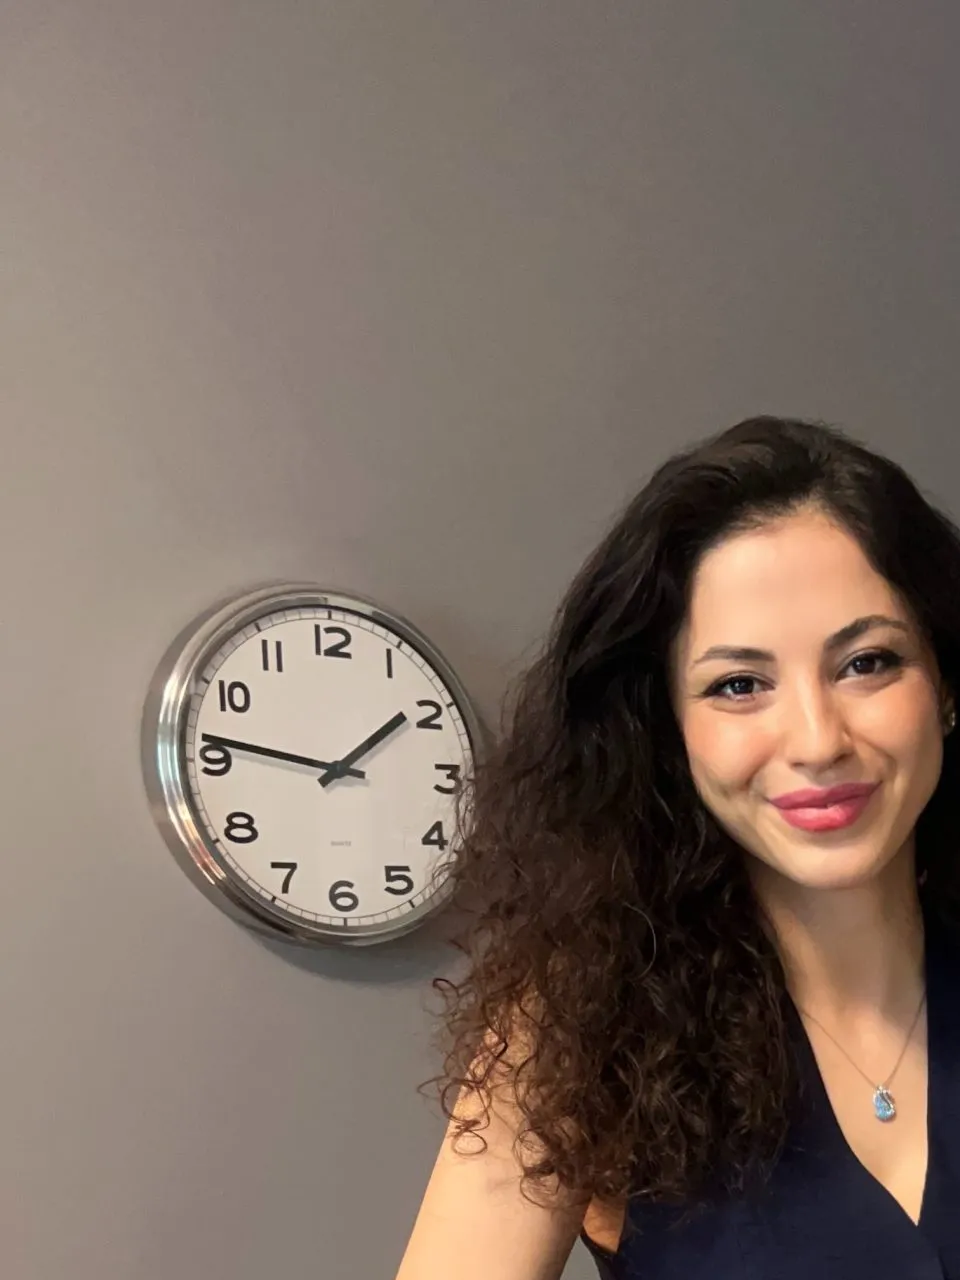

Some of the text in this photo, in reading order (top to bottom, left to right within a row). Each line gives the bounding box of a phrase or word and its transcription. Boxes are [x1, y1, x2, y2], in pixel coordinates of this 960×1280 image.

[261, 639, 283, 673] 11
[314, 623, 353, 660] 12
[385, 648, 393, 679] 1
[218, 679, 251, 714] 10
[415, 699, 443, 731] 2
[199, 740, 233, 777] 9
[432, 763, 462, 795] 3
[223, 811, 259, 844] 8
[421, 820, 449, 852] 4
[270, 861, 298, 895] 7
[384, 865, 414, 896] 5
[328, 880, 359, 913] 6
